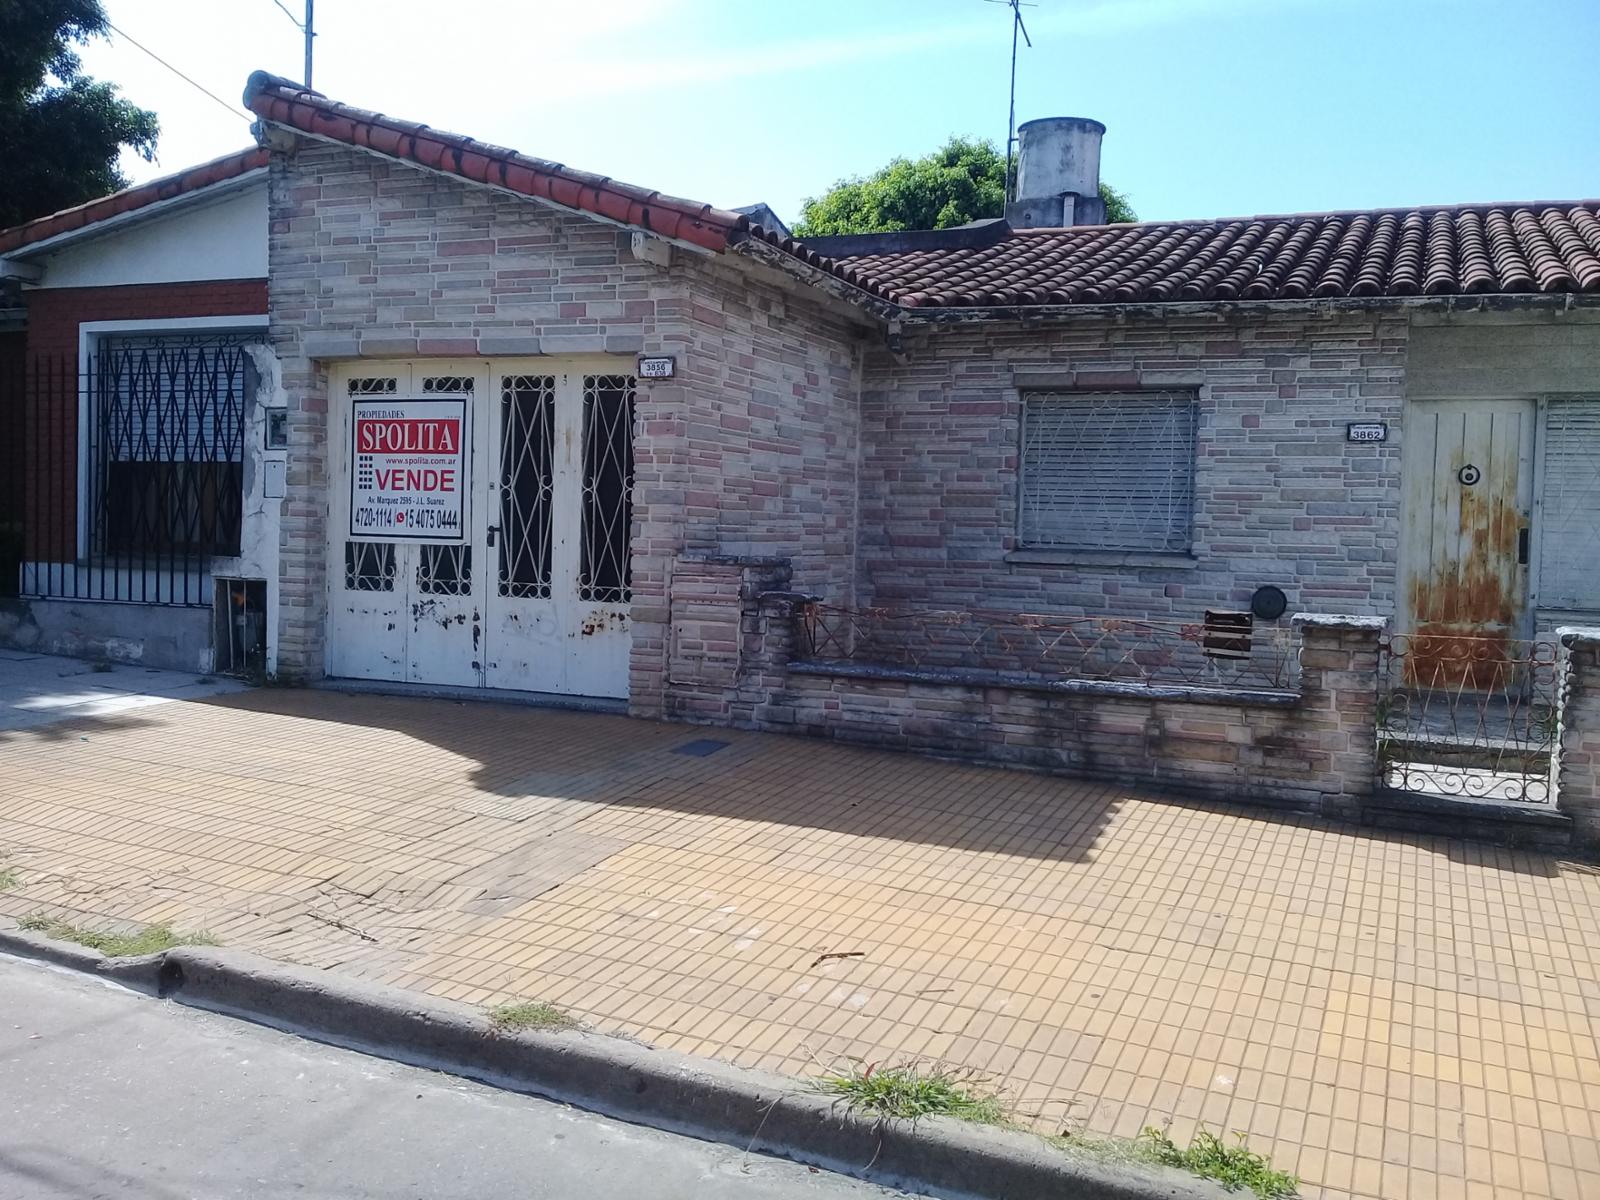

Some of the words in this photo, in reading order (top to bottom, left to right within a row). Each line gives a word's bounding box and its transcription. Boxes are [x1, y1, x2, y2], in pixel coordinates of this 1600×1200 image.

[357, 410, 405, 419] PROPIEDADES
[362, 422, 454, 451] SPOLITA
[1353, 430, 1380, 439] 3862
[385, 457, 456, 466] www.spolita.com.ar
[375, 469, 455, 492] VENDE
[376, 496, 399, 506] Marquez
[426, 497, 445, 505] Suarez
[355, 507, 392, 528] 4720-1114
[405, 508, 414, 528] 15
[415, 508, 435, 529] 4075
[436, 509, 458, 530] 0444
